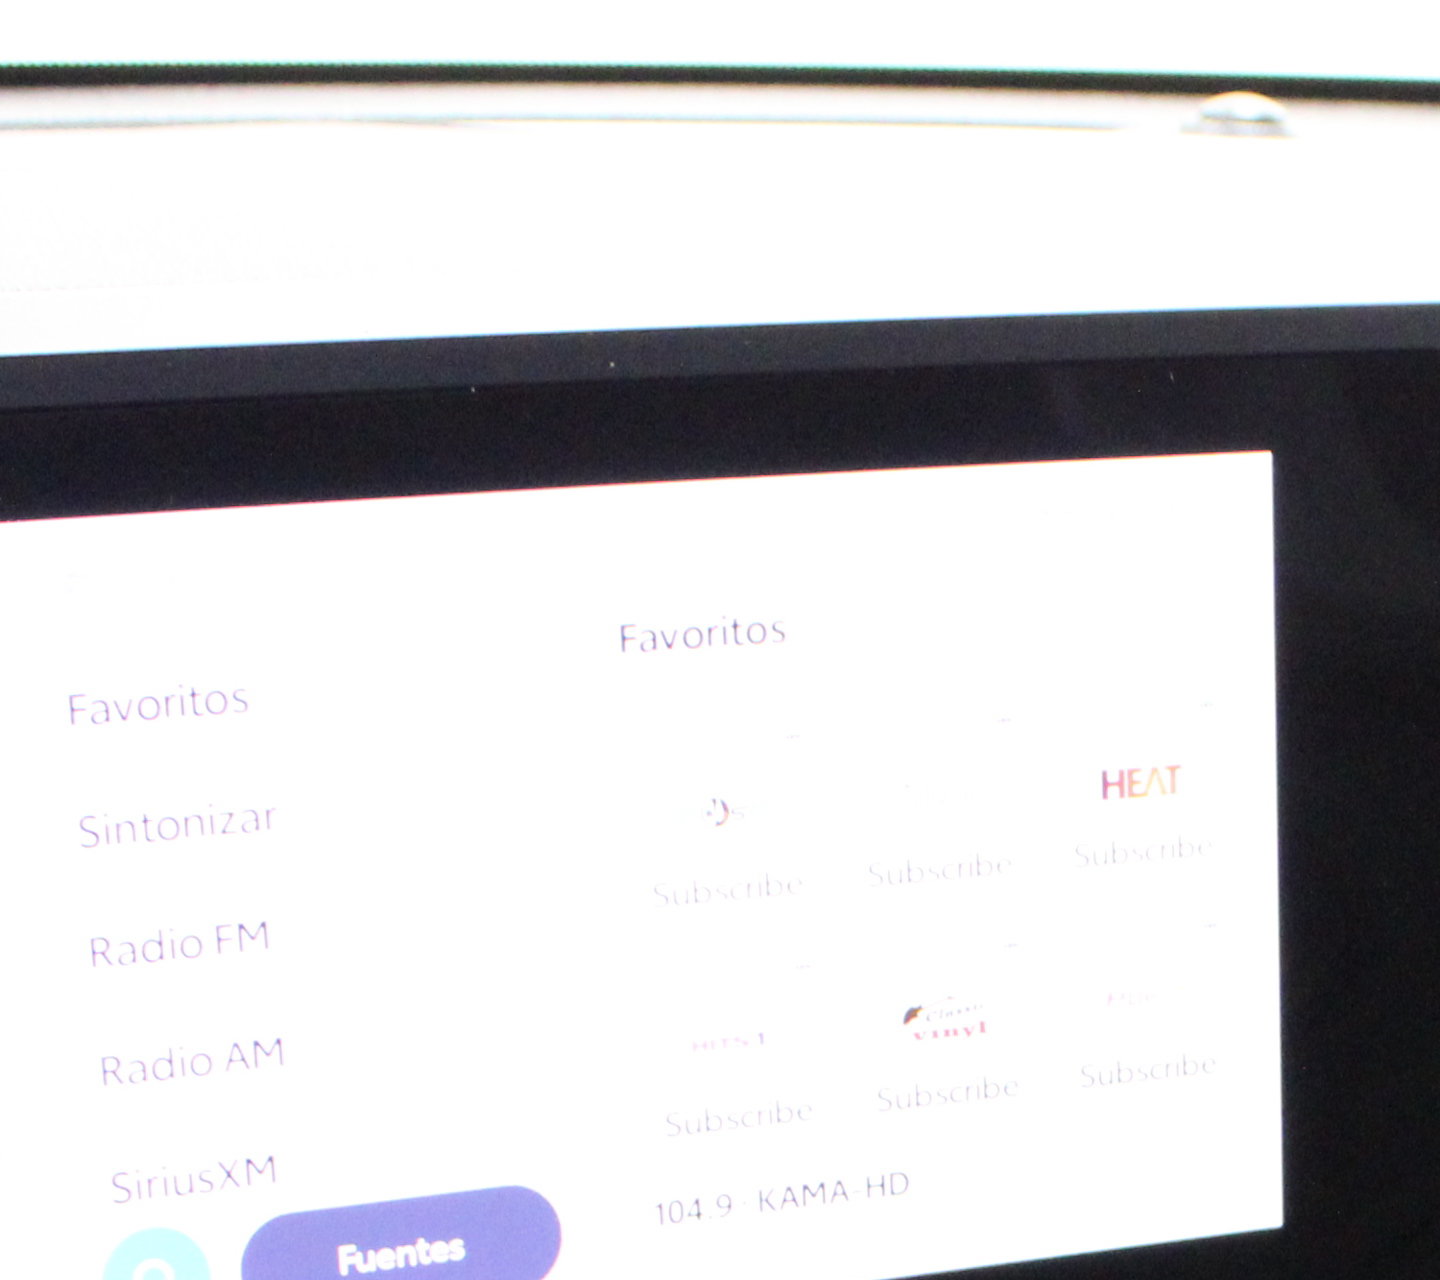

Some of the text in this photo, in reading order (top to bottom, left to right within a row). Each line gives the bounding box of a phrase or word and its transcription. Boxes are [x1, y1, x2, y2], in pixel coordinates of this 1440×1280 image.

[619, 616, 786, 653] Favoritos
[68, 684, 249, 726] Favoritos
[1101, 764, 1183, 800] HEAT
[79, 803, 276, 848] Sintonizar
[869, 853, 1011, 885] Subscribe
[1075, 835, 1211, 866] Subscribe
[653, 872, 802, 906] Subscribe
[90, 921, 269, 968] Radio FM
[101, 1037, 284, 1087] Radio AM
[1081, 1054, 1216, 1088] Subscribe
[878, 1076, 1018, 1112] Subscribe
[666, 1100, 812, 1137] Subscribe
[112, 1155, 276, 1204] SiriusXM
[656, 1172, 909, 1225] 104.9 KAMA-HD
[337, 1236, 466, 1277] Fuentes
